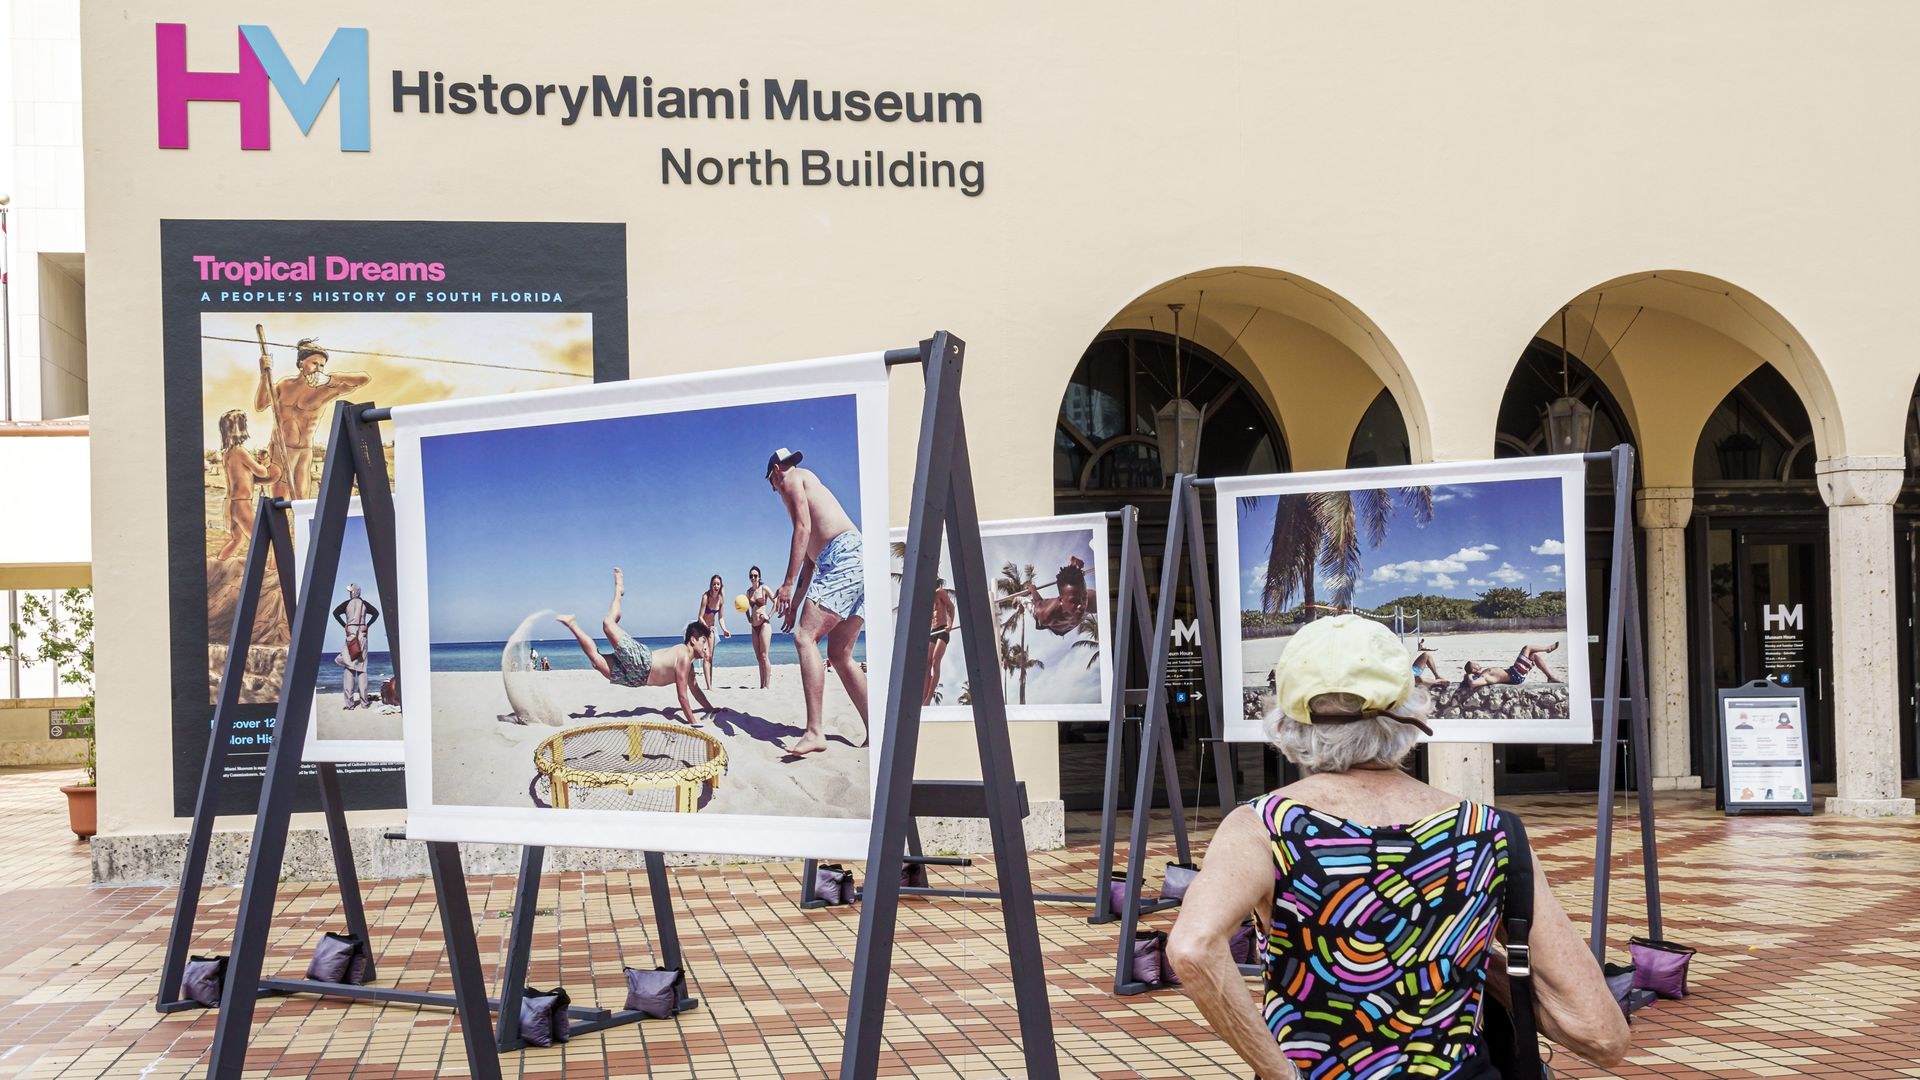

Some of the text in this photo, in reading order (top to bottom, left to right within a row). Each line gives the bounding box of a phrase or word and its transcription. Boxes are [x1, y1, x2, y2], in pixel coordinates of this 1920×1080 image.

[156, 22, 370, 152] HM
[393, 70, 984, 125] HistoryMiami Museum
[661, 147, 986, 197] North Building
[193, 255, 446, 286] Tropical Dreams
[200, 291, 563, 303] A PEOPLE'S HISTORY OF SOUTH FLORIDA
[1763, 604, 1803, 631] HM
